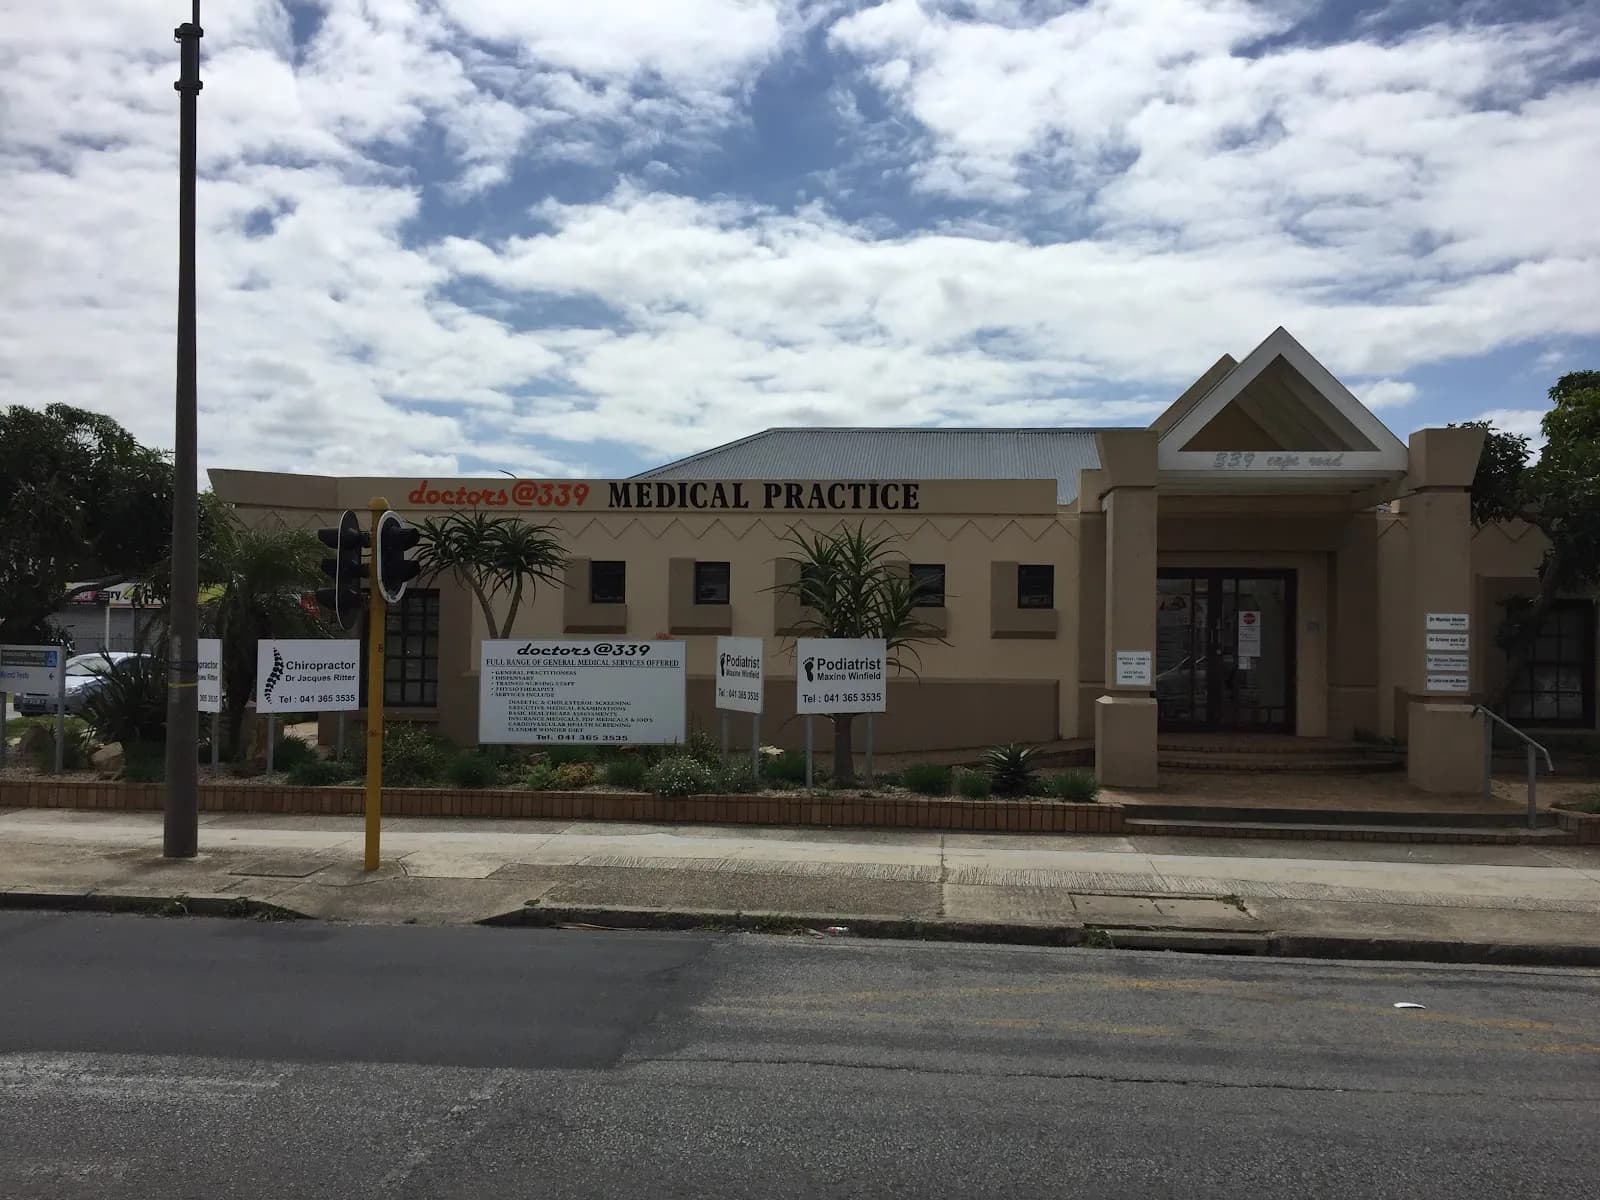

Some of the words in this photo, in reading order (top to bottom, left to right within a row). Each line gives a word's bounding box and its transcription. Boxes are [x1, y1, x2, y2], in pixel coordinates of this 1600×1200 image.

[1214, 452, 1255, 468] 339
[408, 480, 590, 506] doctors@339
[608, 482, 749, 509] MEDICAL
[764, 482, 920, 509] PRACTICE
[517, 643, 650, 656] doctors@339
[486, 659, 504, 667] FULL
[506, 659, 530, 667] RANGE
[532, 659, 541, 667] OF
[543, 659, 576, 667] GENERAL
[578, 659, 611, 667] MEDICAL
[612, 659, 644, 667] SERVICES
[646, 659, 679, 667] OFFERED
[726, 654, 760, 668] Podiatrist
[817, 658, 881, 671] Podiatrist
[286, 661, 356, 672] Chiropractor
[297, 674, 331, 683] Jacques
[741, 670, 759, 679] Winfield
[817, 672, 846, 681] Maxine
[849, 672, 881, 680] Winfield
[748, 692, 759, 701] 3535
[802, 694, 816, 703] Tel
[824, 694, 839, 703] 041
[842, 694, 858, 702] 365
[860, 693, 881, 702] 3535
